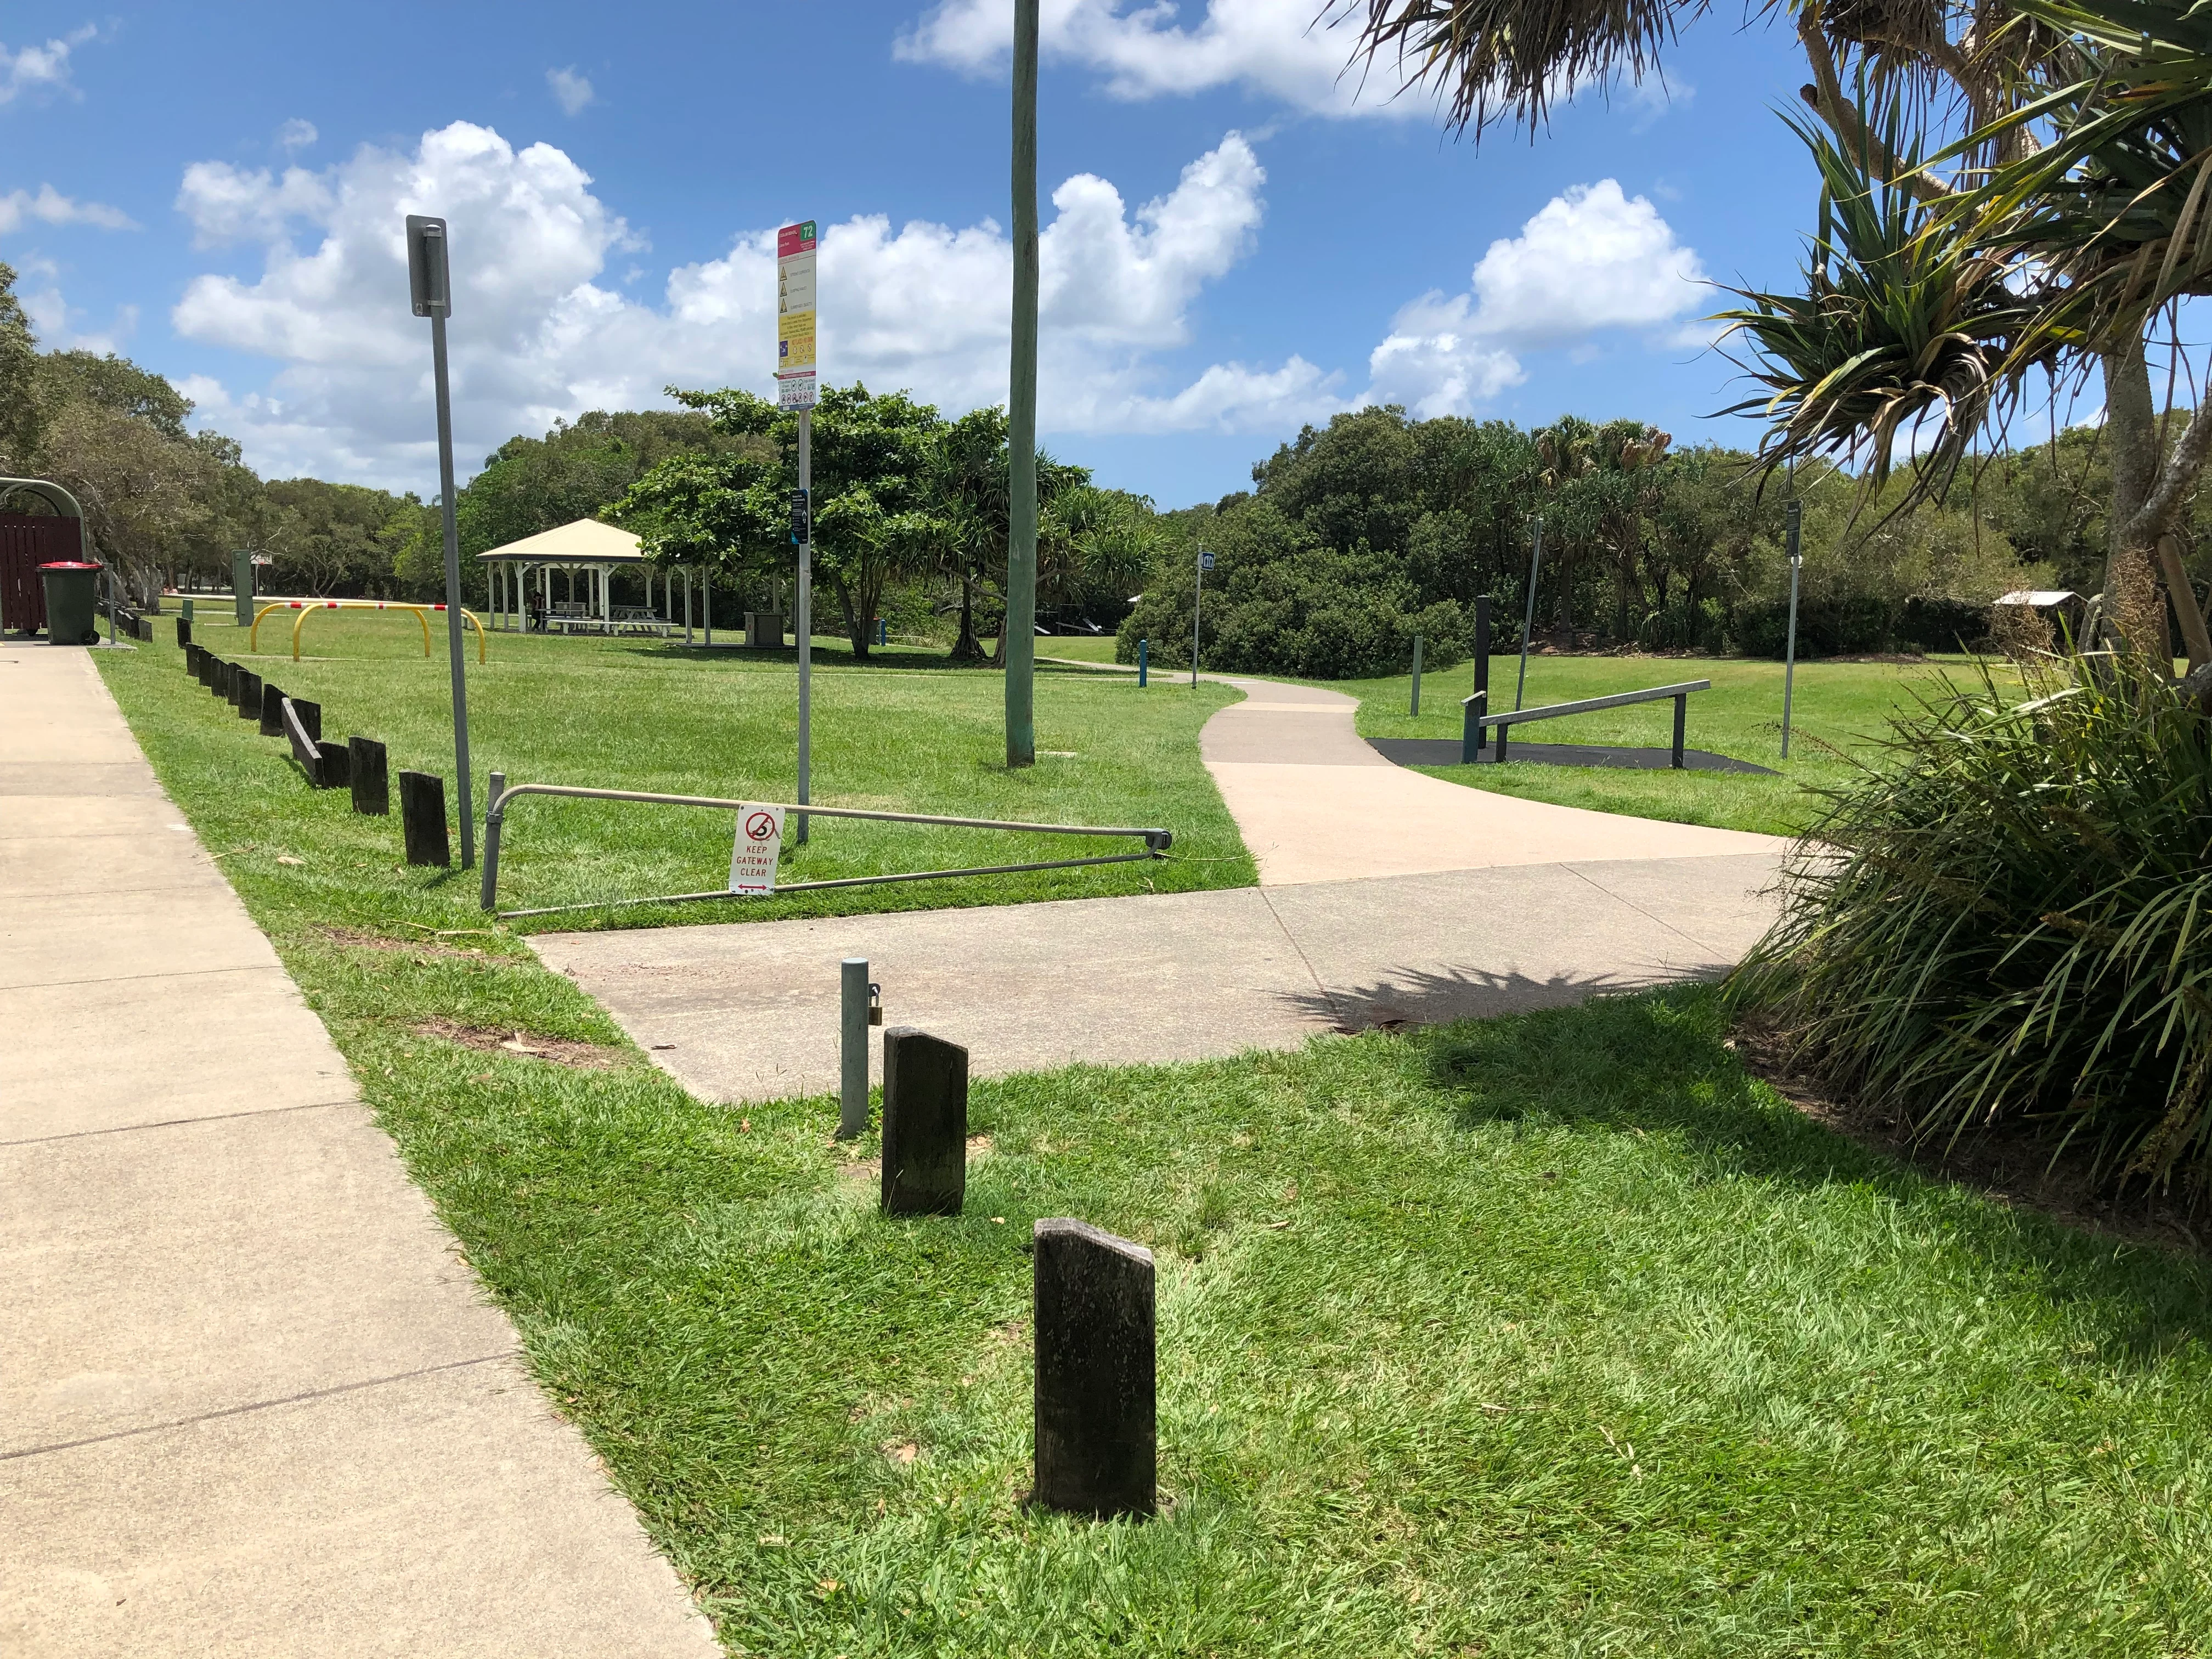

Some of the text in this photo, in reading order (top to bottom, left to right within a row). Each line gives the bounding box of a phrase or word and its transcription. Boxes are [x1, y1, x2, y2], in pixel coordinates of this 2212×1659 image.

[803, 225, 813, 239] 72
[746, 845, 768, 854] KEEP
[736, 856, 774, 866] GATEWAY
[740, 867, 767, 877] CLEAR
